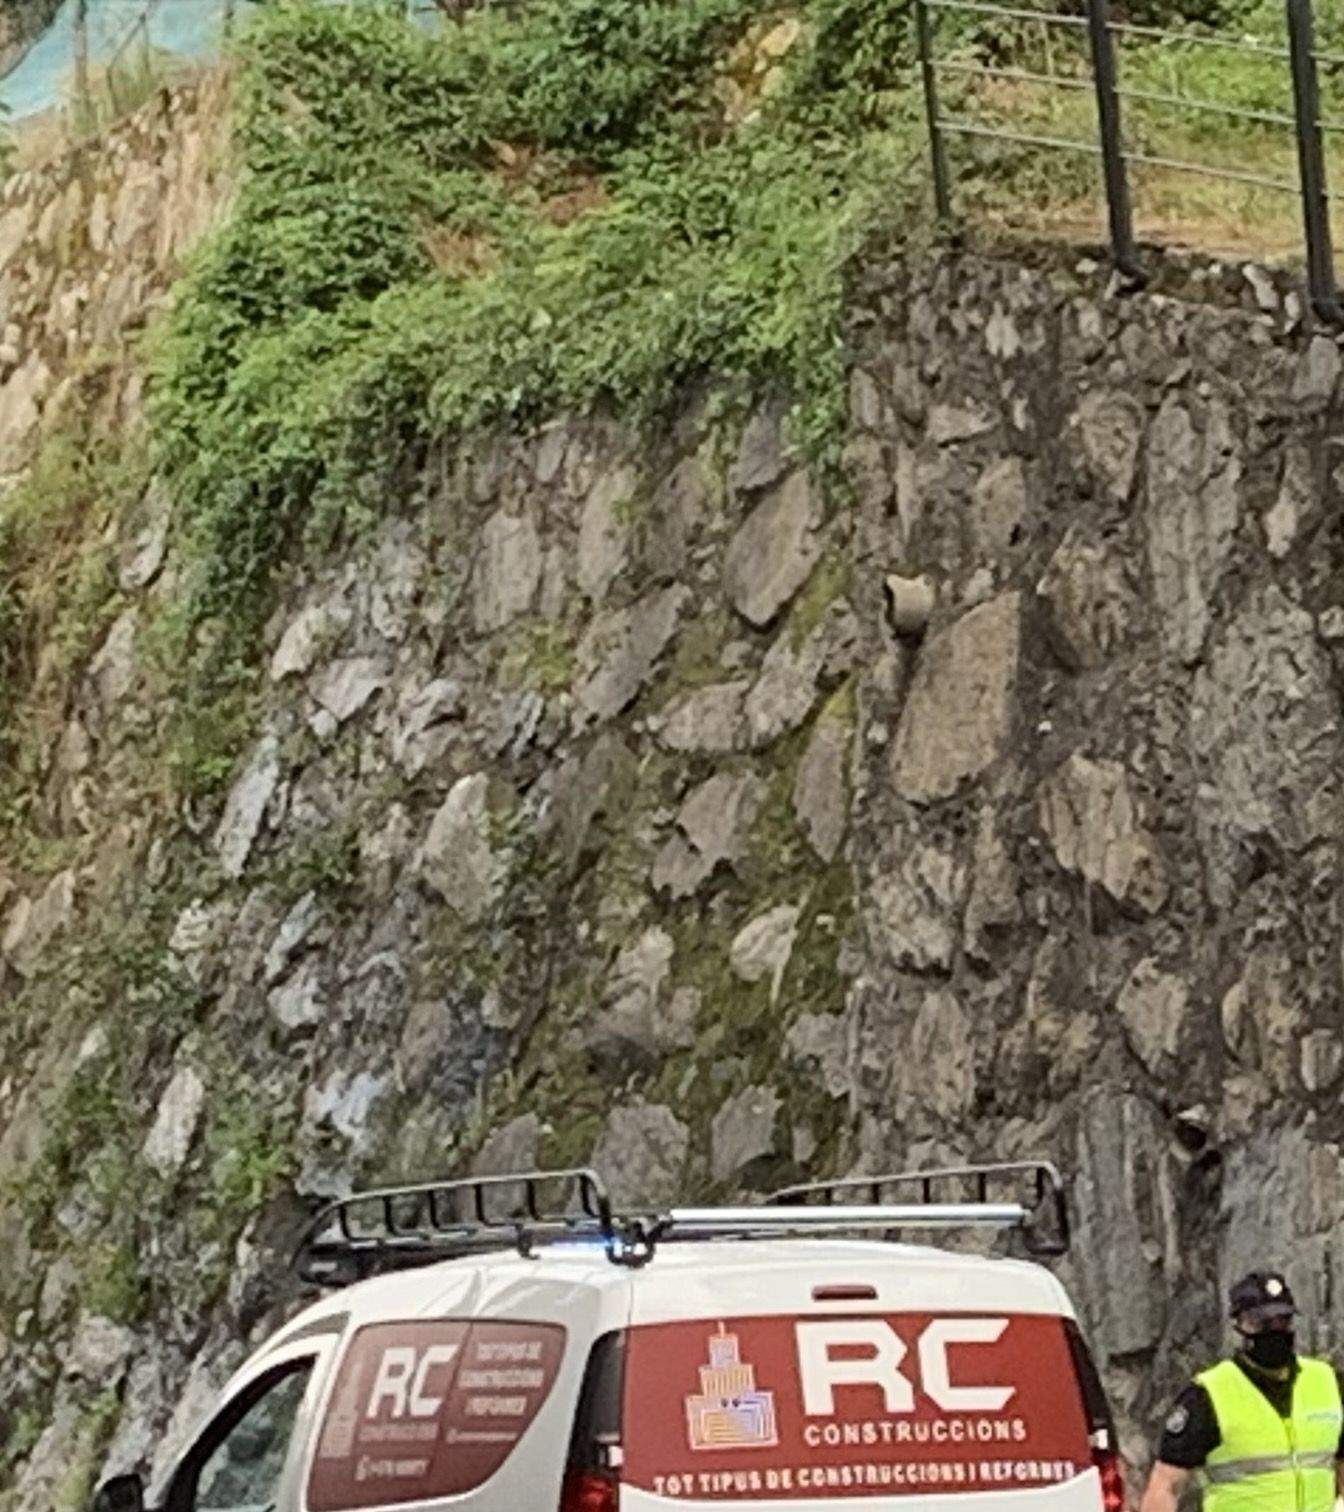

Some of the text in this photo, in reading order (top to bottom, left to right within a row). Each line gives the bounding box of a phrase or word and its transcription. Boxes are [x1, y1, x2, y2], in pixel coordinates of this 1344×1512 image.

[366, 1343, 460, 1419] RC
[795, 1319, 1016, 1416] RC
[804, 1418, 1027, 1447] CONSTRUCCIONS
[653, 1474, 693, 1496] TOT
[700, 1470, 761, 1493] TIPUS
[766, 1467, 792, 1490] DE
[797, 1462, 965, 1488] CONSTRUCCIONS
